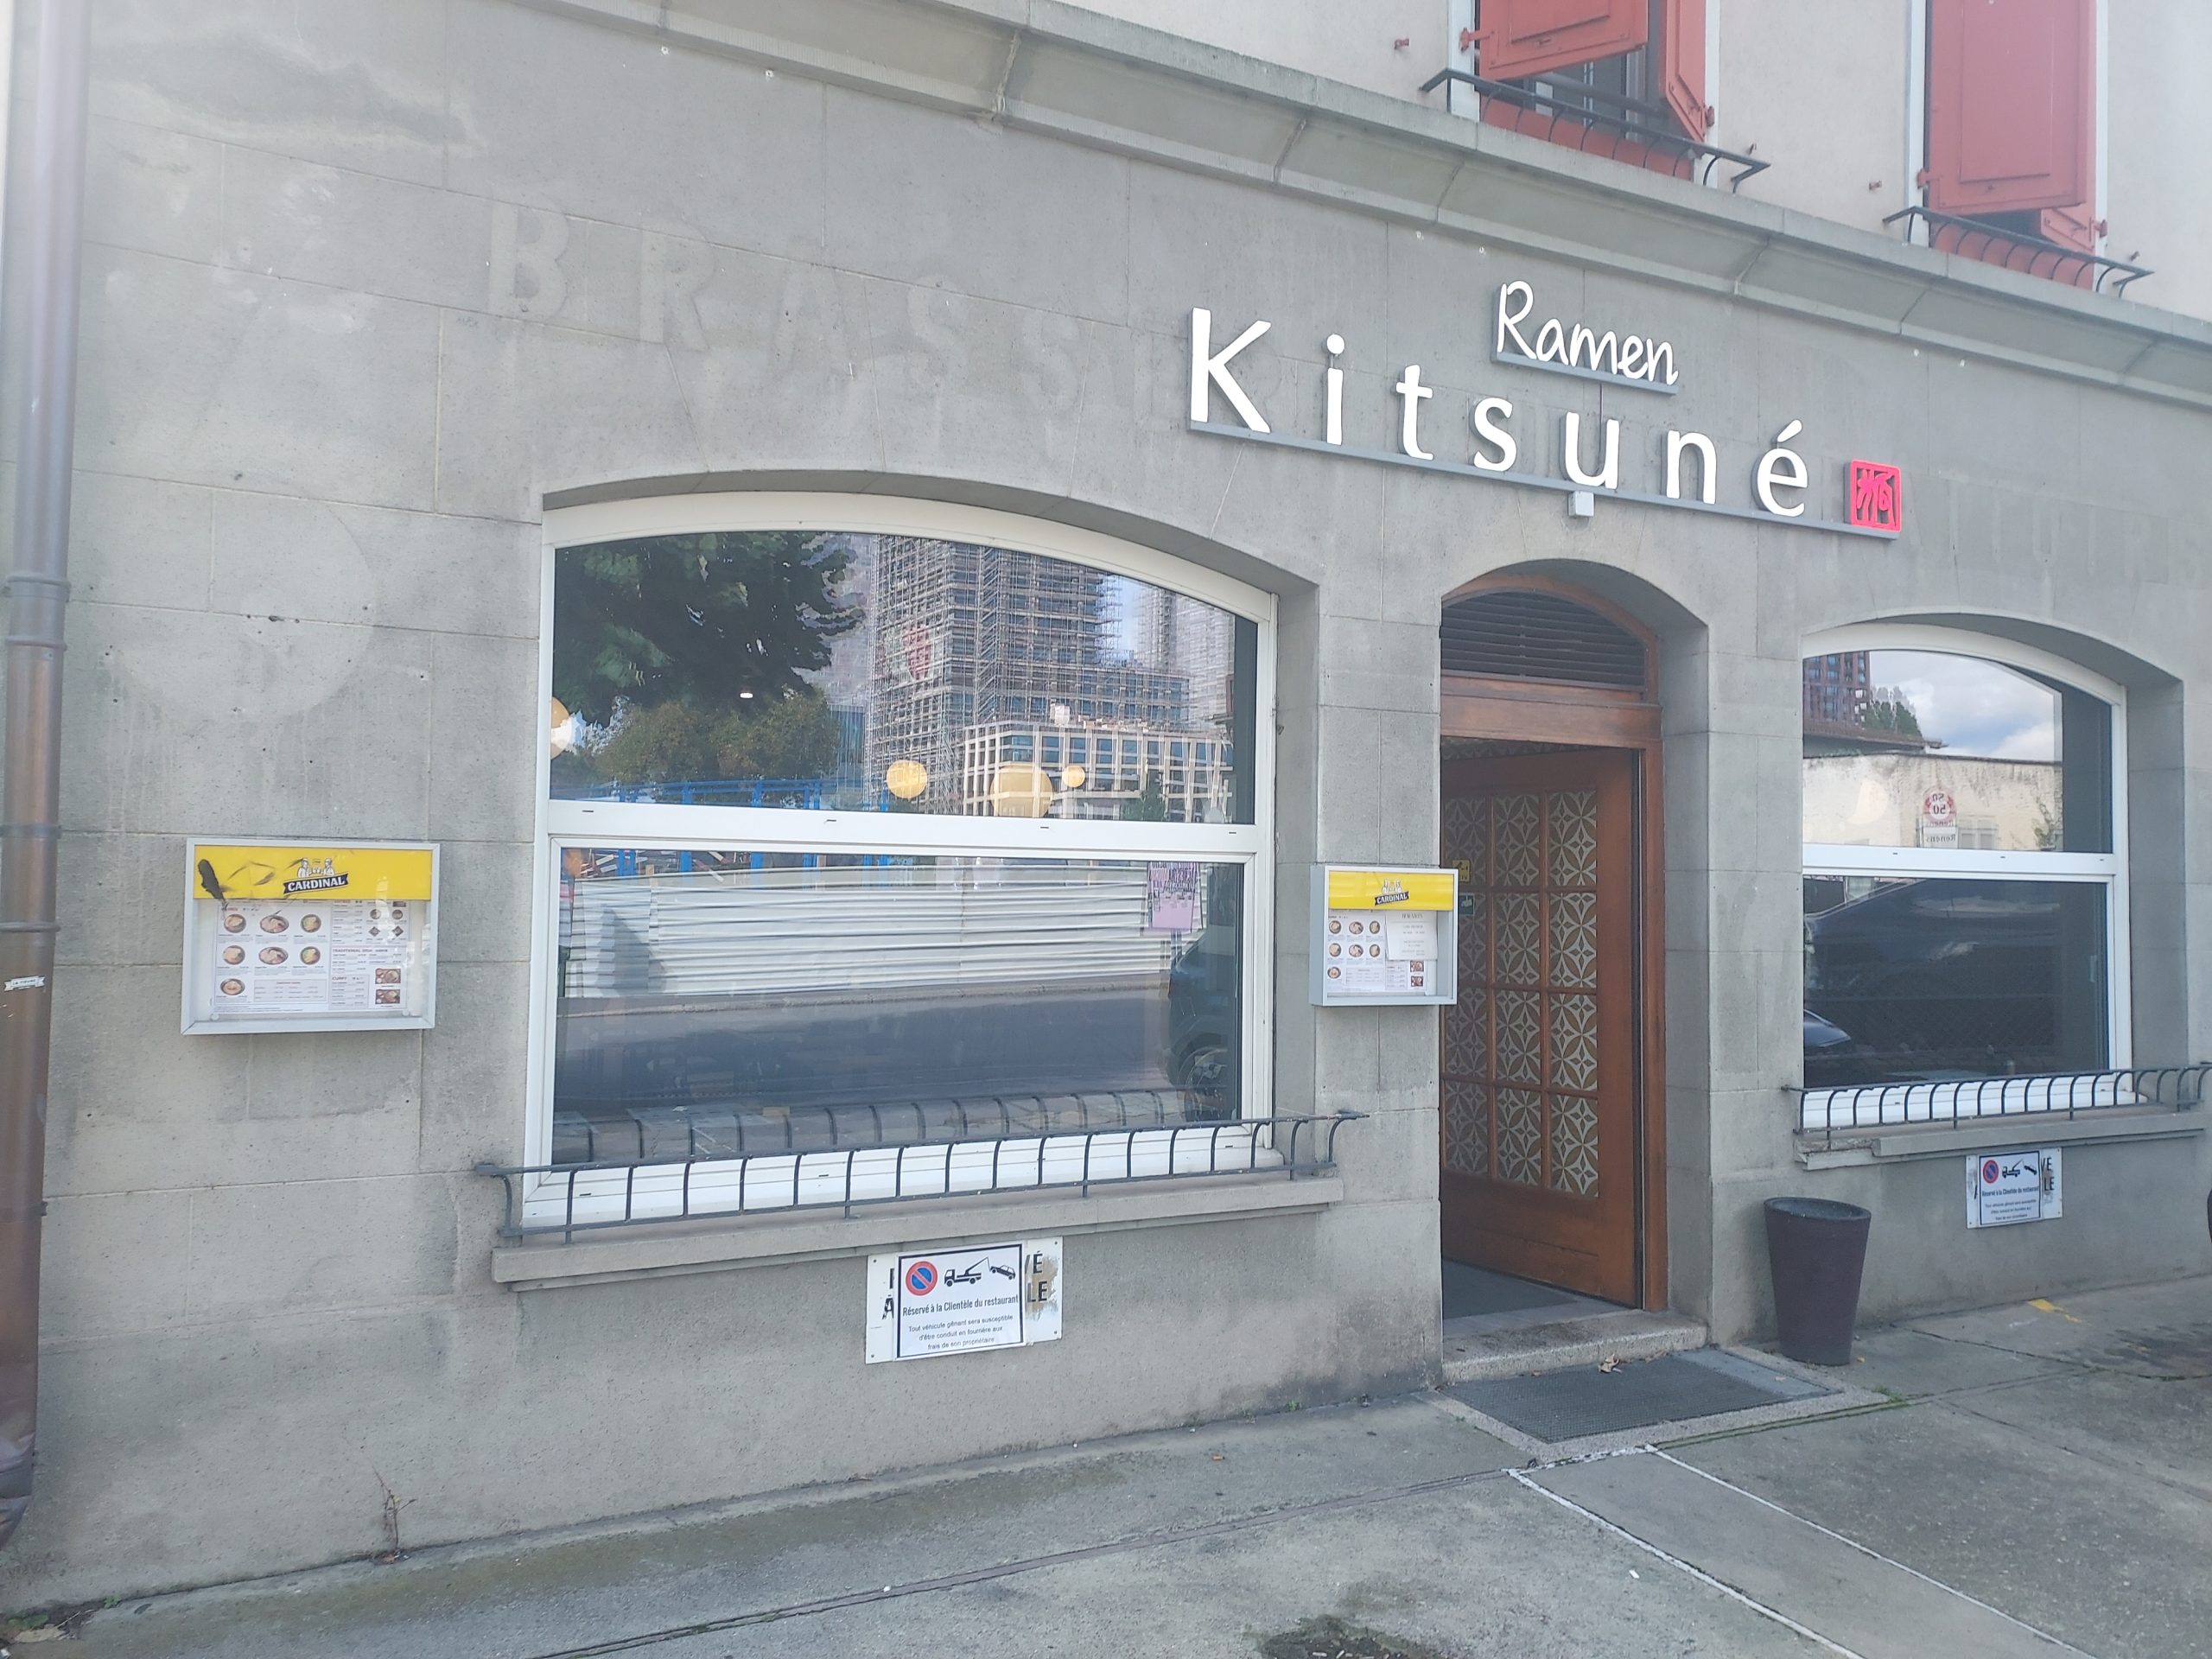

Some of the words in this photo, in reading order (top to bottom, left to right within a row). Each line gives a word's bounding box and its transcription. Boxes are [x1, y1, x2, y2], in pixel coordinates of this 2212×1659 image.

[1497, 280, 1679, 385] Ramen
[1190, 307, 1810, 518] Kitsuné
[287, 875, 346, 892] CARDINAL
[1376, 893, 1408, 905] CARDINAL
[903, 1304, 930, 1317] Réservé
[931, 1304, 936, 1313] à
[936, 1302, 943, 1312] la
[944, 1299, 973, 1312] Clientèle
[974, 1298, 983, 1307] du
[984, 1294, 1019, 1306] restaurant
[922, 1321, 946, 1331] véhicule
[947, 1319, 967, 1329] gênant
[982, 1313, 1014, 1325] susceptible
[918, 1332, 936, 1341] d'être
[936, 1329, 957, 1339] conduit
[927, 1342, 940, 1351] frais
[962, 1337, 995, 1347] propriétaire
